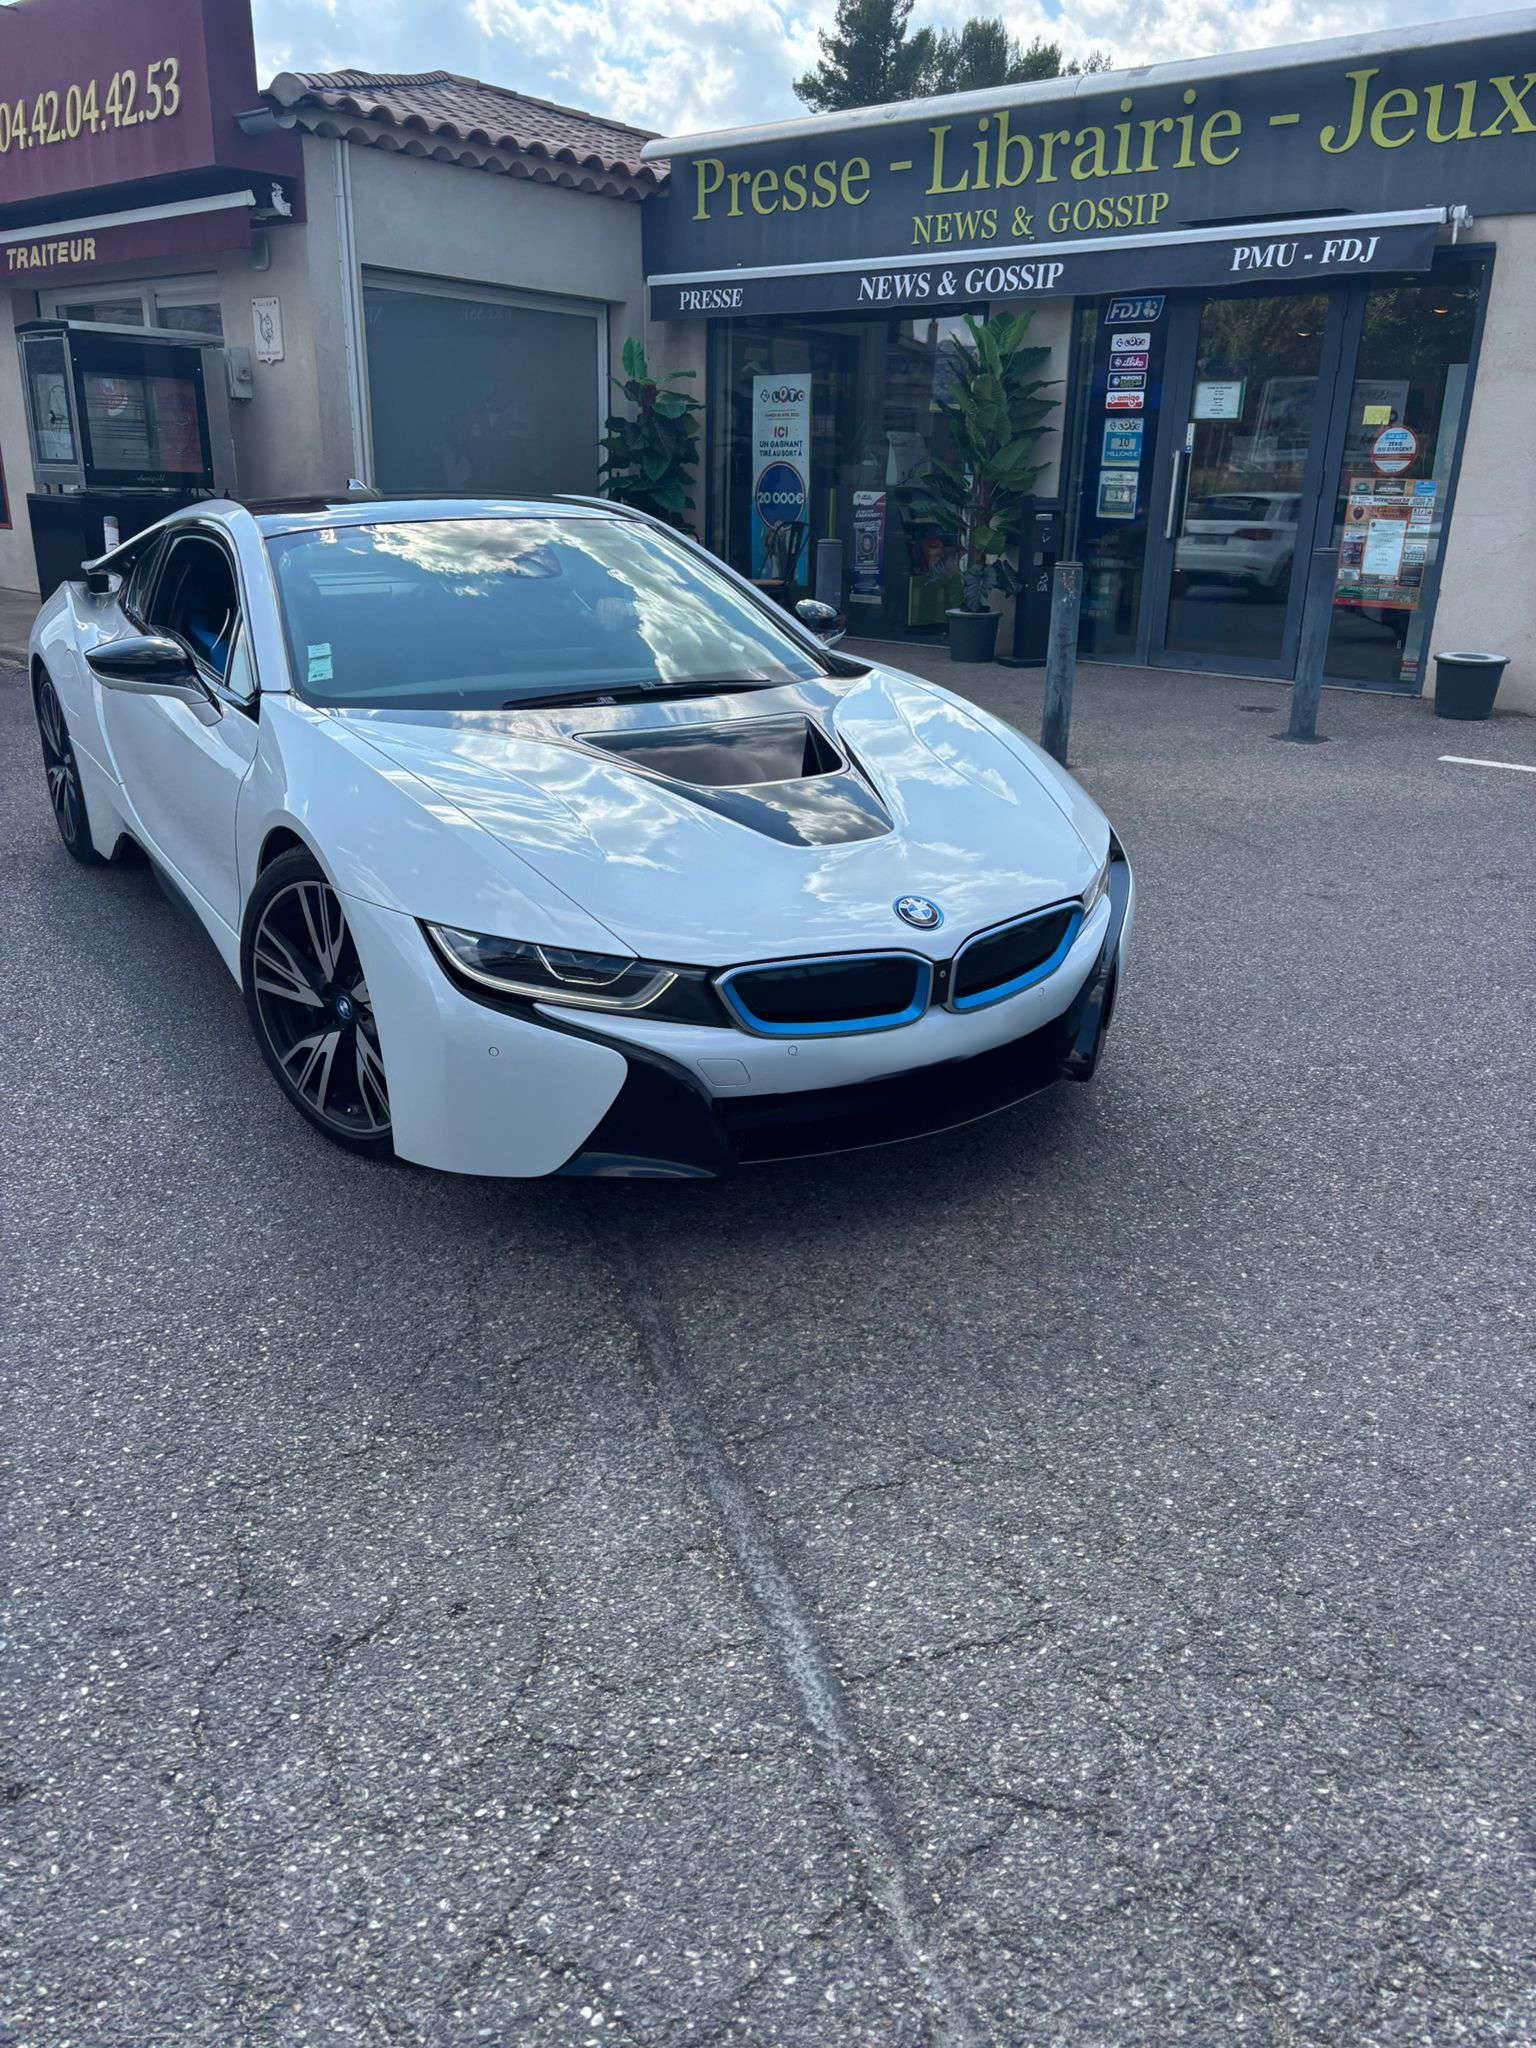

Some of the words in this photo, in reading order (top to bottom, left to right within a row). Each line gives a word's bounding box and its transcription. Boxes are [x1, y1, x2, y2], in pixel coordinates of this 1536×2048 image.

[0, 57, 181, 153] 04.42.04.42.53
[691, 156, 870, 221] Presse
[889, 160, 912, 172] -
[926, 89, 1242, 196] Librairie
[1269, 113, 1300, 126] -
[1319, 68, 1536, 154] Jeux
[911, 208, 998, 246] NEWS
[1011, 205, 1034, 237] &
[1048, 192, 1170, 234] GOSSIP
[6, 237, 97, 271] TRAITEUR
[679, 287, 744, 312] PRESSE
[857, 271, 932, 301] NEWS
[937, 268, 958, 296] &
[964, 261, 1065, 294] GOSSIP
[1230, 243, 1300, 272] PMU
[1319, 236, 1381, 265] FDJ
[1109, 302, 1143, 320] FDJ
[774, 426, 789, 438] ICI
